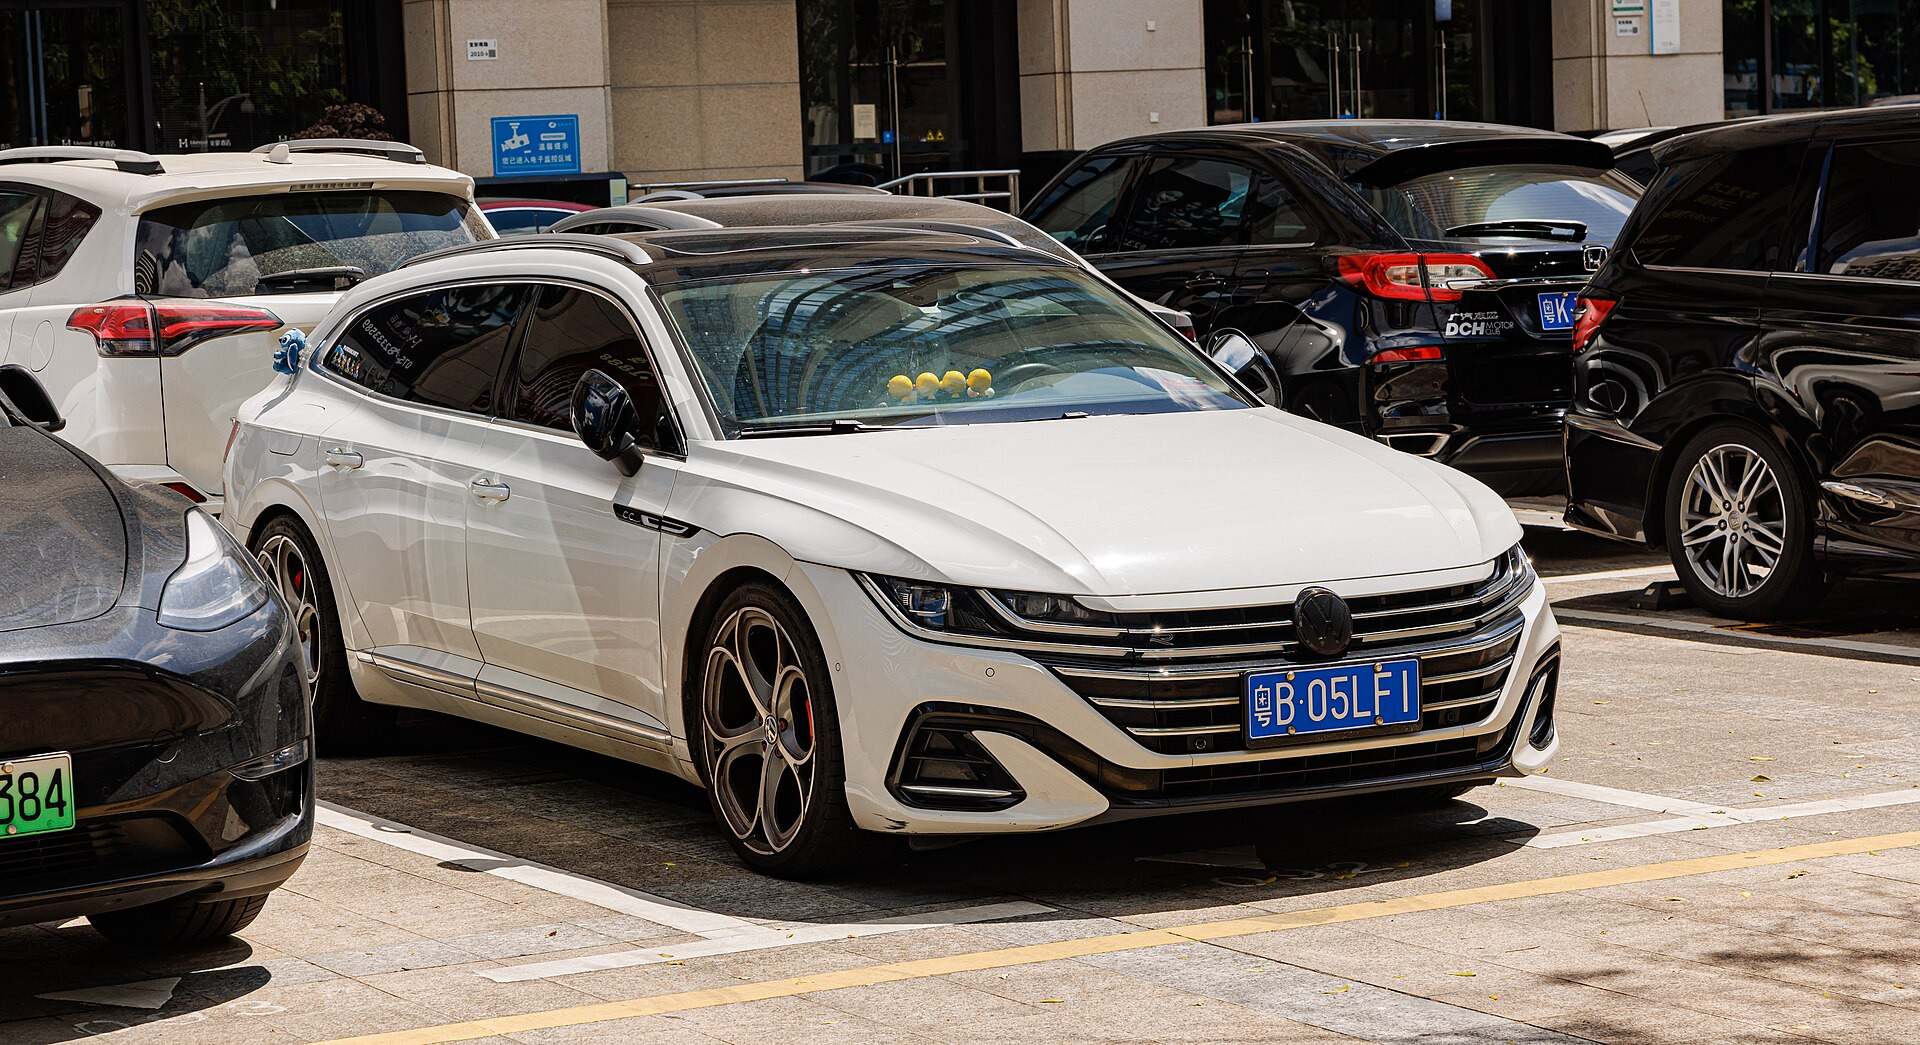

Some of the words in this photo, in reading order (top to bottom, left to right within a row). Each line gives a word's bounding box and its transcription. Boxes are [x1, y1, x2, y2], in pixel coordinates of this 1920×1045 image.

[539, 142, 569, 151] 温馨提示
[502, 154, 572, 165] 您已进入电子监控区域
[1445, 321, 1485, 336] DCH
[1485, 321, 1515, 330] MOTOR
[1254, 669, 1409, 727] 粤B·05LF1
[0, 768, 67, 824] 384
